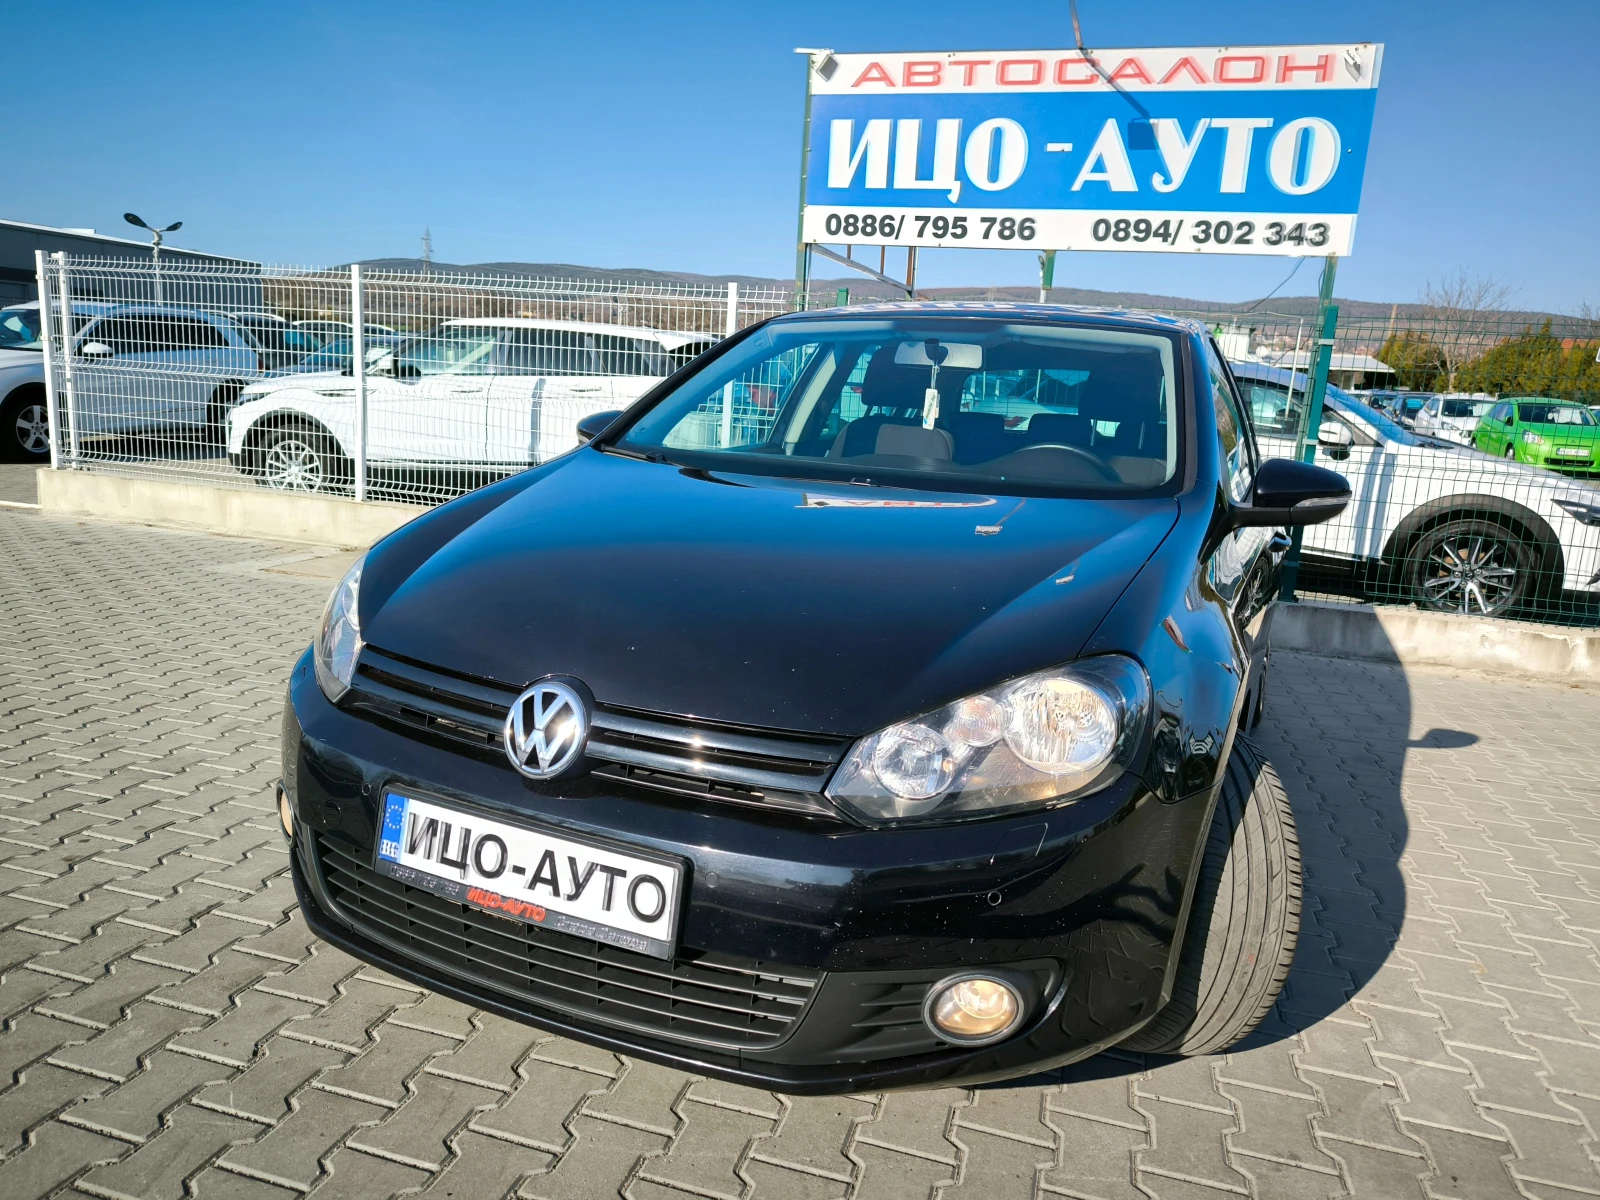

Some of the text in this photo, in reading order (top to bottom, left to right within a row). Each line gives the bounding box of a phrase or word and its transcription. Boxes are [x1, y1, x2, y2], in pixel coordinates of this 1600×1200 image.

[850, 53, 1336, 88] АВТОСАЛОН
[825, 213, 1037, 241] 0886/ 795 786
[1091, 218, 1331, 247] 0894/ 302 343
[403, 811, 667, 923] ИЦО-АУТО
[466, 885, 547, 922] ИЦО-АУТО
